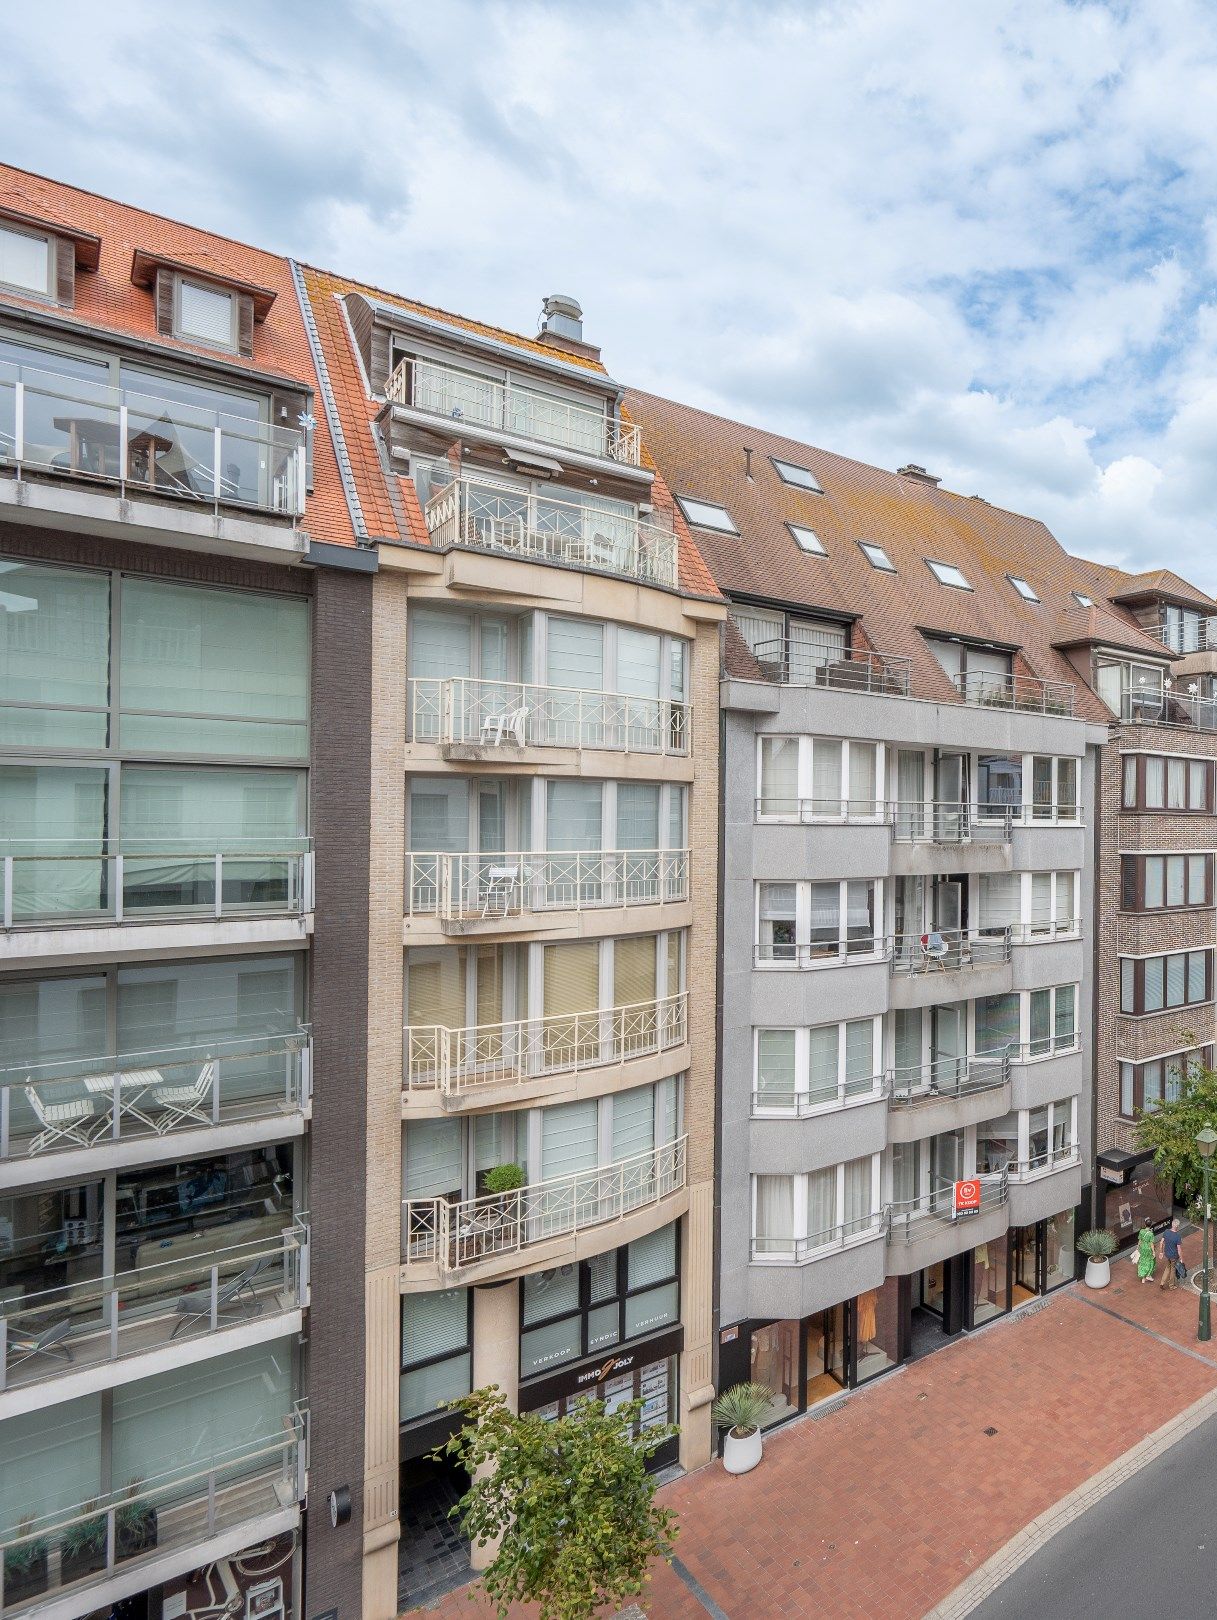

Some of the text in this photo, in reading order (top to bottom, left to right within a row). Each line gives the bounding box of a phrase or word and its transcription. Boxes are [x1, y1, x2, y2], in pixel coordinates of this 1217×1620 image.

[635, 1312, 669, 1328] VERHUUR
[590, 1331, 618, 1345] SYNDIC
[532, 1348, 572, 1366] VERKOOP
[578, 1356, 634, 1384] IMMO JOLY
